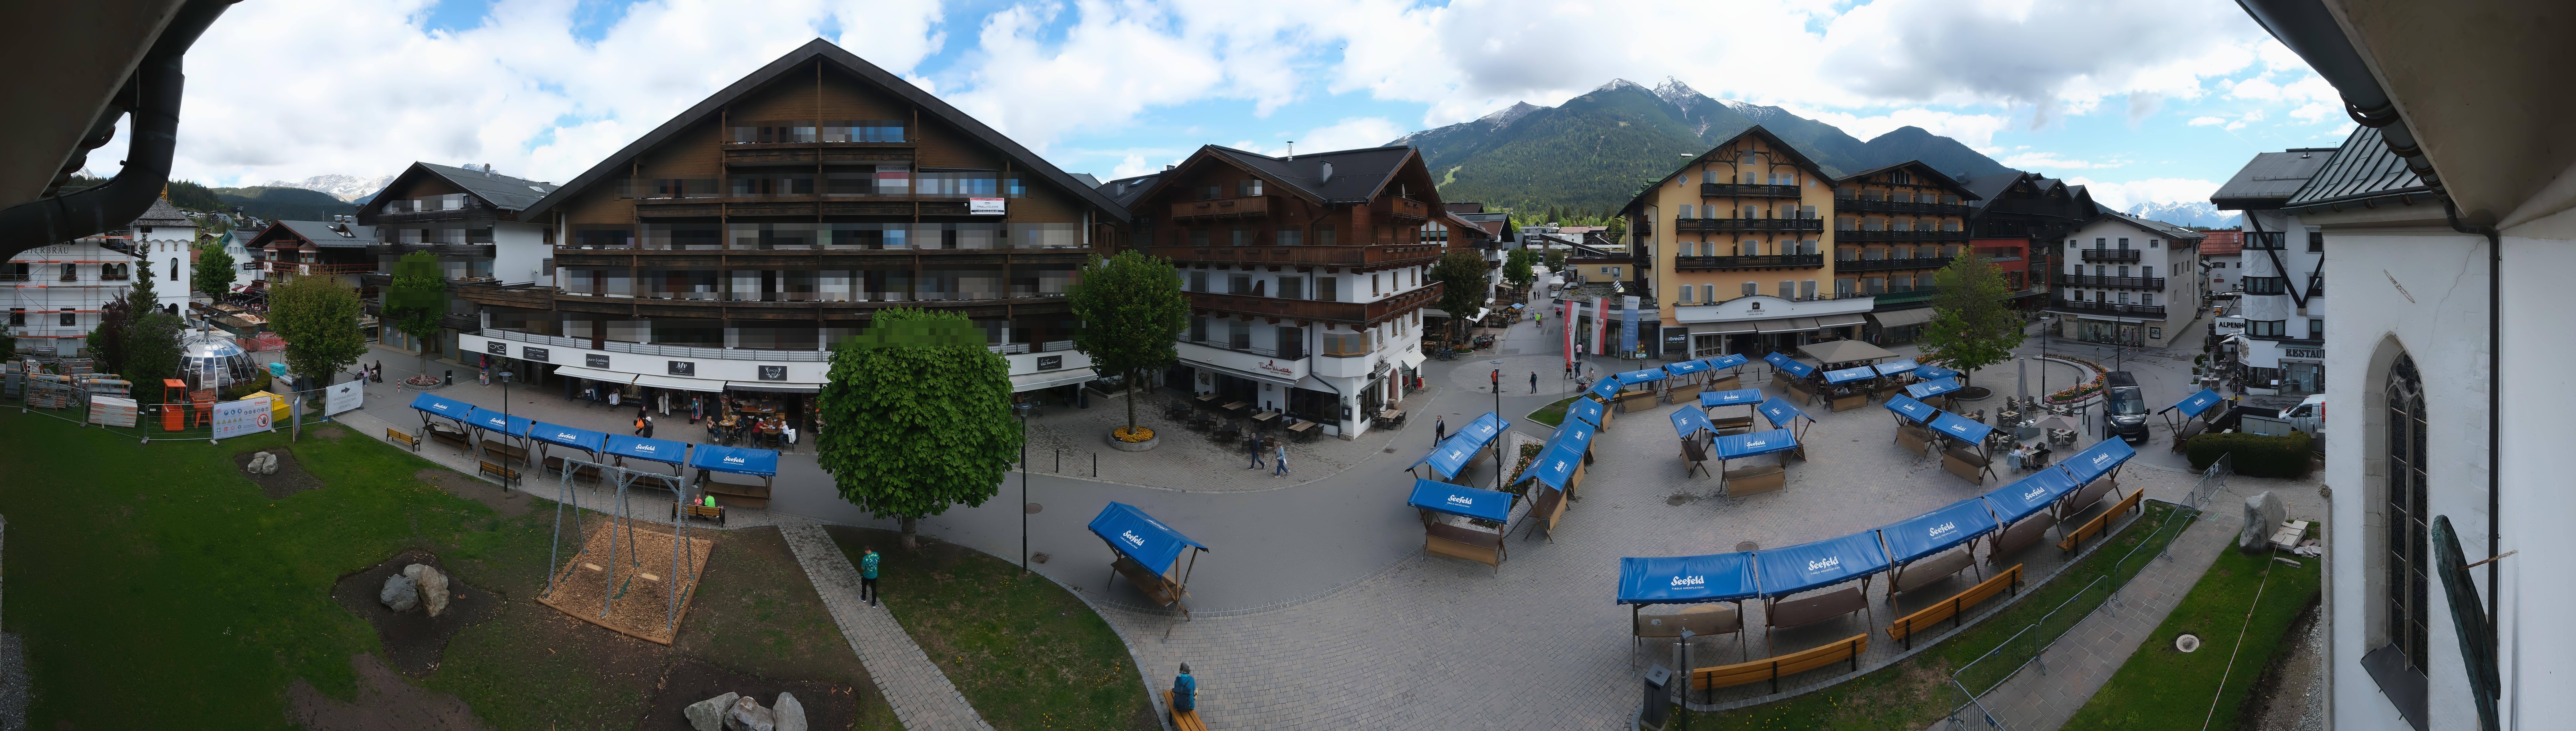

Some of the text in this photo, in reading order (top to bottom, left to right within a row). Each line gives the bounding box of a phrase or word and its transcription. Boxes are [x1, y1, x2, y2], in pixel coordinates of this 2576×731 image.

[1406, 343, 1414, 352] SAILER
[1272, 364, 1293, 373] Weinstube
[1376, 365, 1389, 378] RESTAURANT
[334, 397, 356, 406] KONGRESSZENTRUM
[1450, 450, 1461, 460] Seefeld
[2093, 453, 2109, 464] Seefeld
[1555, 460, 1565, 472] Seefeld
[2025, 486, 2045, 500] Seefeld
[1448, 494, 1472, 505] Seefeld
[1929, 521, 1955, 537] Seefeld
[1123, 530, 1145, 546] Seefeld
[1126, 540, 1138, 549] HOCHPLATEAU
[1808, 556, 1839, 571] Seefeld
[1671, 575, 1705, 586] Seefeld
